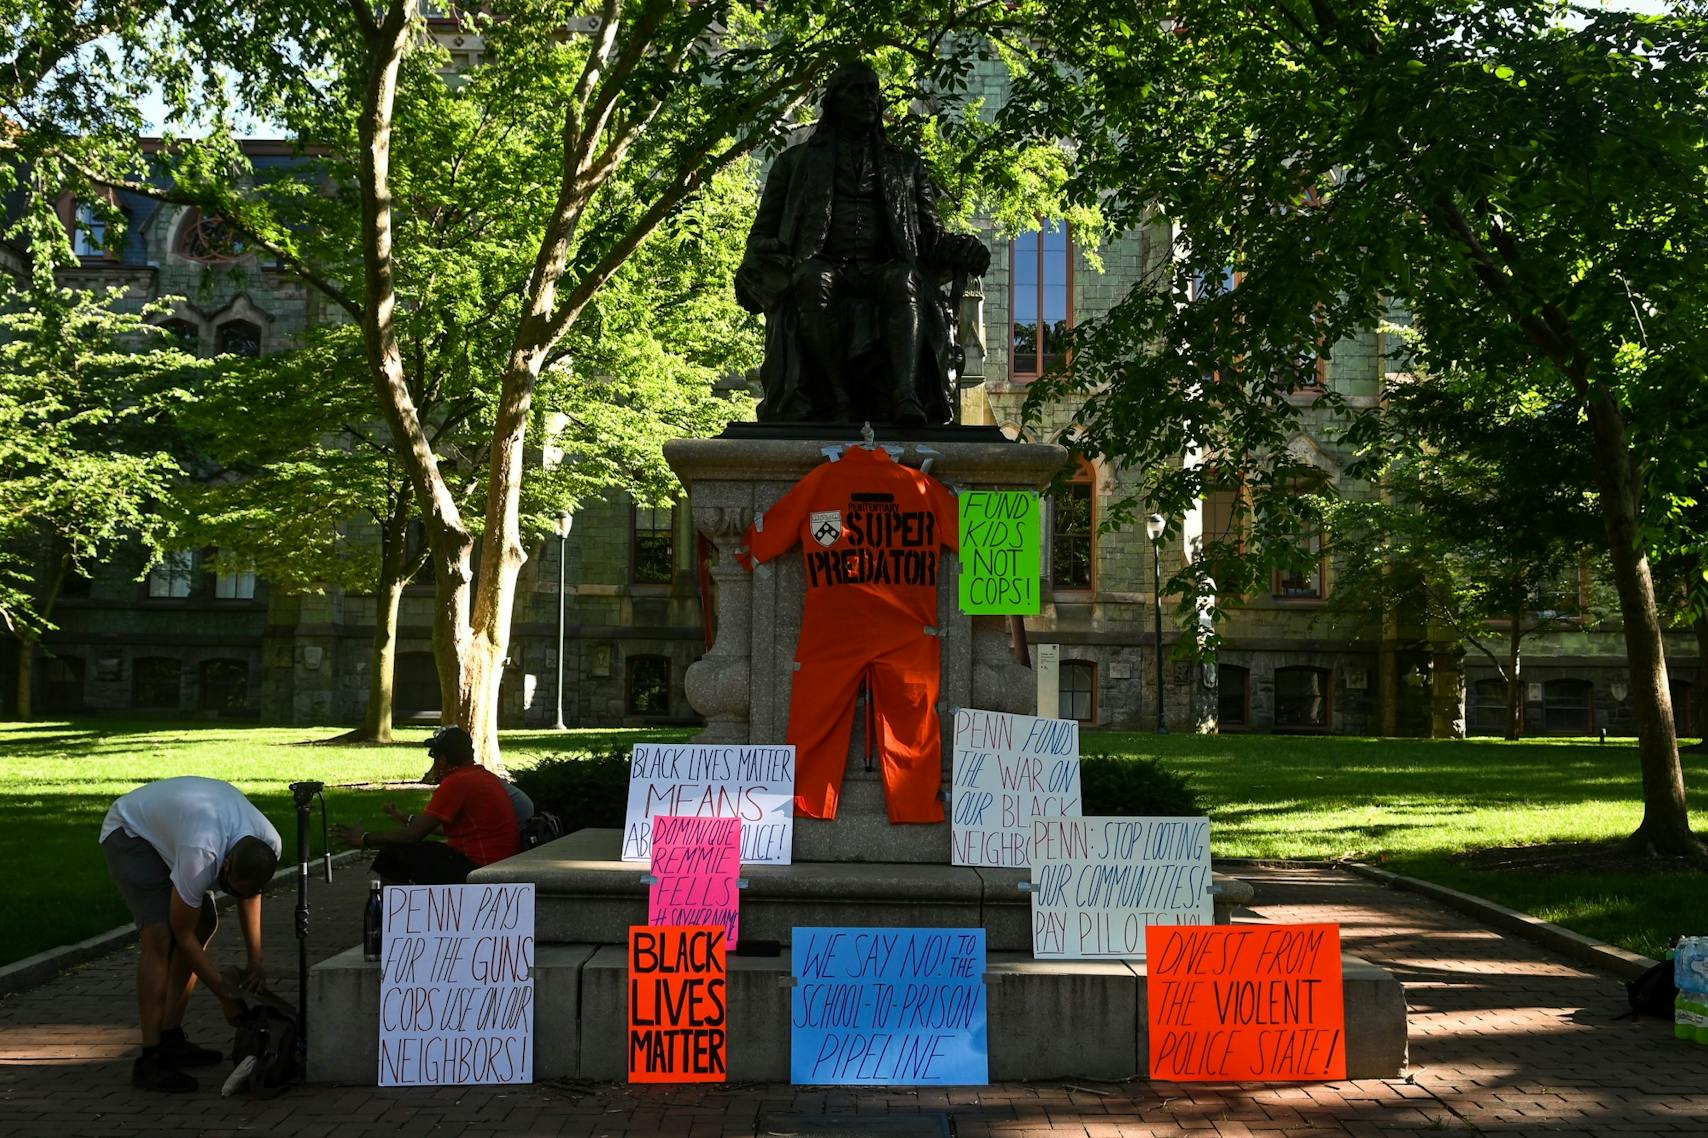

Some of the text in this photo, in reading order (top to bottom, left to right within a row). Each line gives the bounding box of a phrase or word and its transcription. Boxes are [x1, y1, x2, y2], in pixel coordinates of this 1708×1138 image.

[848, 503, 899, 512] PENITENTIARY
[963, 492, 1029, 519] FUND
[846, 511, 935, 547] SUPER
[963, 521, 1025, 548] KIDS
[807, 548, 936, 587] PREDATOR
[974, 549, 1023, 576] NOT
[970, 577, 1030, 605] COPS!
[956, 711, 1077, 755] PENN FUNDS
[632, 748, 792, 782] BLACK LIVES MATTER
[954, 750, 1078, 793] THE WAR ON
[645, 783, 768, 821] MEANS
[955, 791, 993, 825] OUR
[653, 819, 739, 845] DOMINIQUE
[1034, 821, 1207, 861] PENN: STOP LOOTING
[651, 847, 736, 874] REMMIE
[657, 877, 734, 906] FELLS
[1038, 863, 1207, 910] OUR COMMUNITIES!
[389, 887, 530, 933] PENN PAYS
[1036, 911, 1066, 951] PAY
[382, 936, 533, 985] FOR THE GUNS
[634, 932, 725, 973] BLACK
[802, 934, 976, 979] WE SAY NO! TO
[950, 957, 976, 978] THE
[1156, 929, 1324, 975] DIVEST FROM
[383, 986, 532, 1033] COPS USE ON OUR
[632, 979, 726, 1027] LIVES
[1158, 979, 1322, 1026] THE VIOLENT
[381, 1036, 526, 1084] NEIGHBORS!
[630, 1029, 725, 1073] MATTER
[812, 1034, 955, 1079] PIPELINE
[1154, 1028, 1339, 1075] POLICE STATE!
